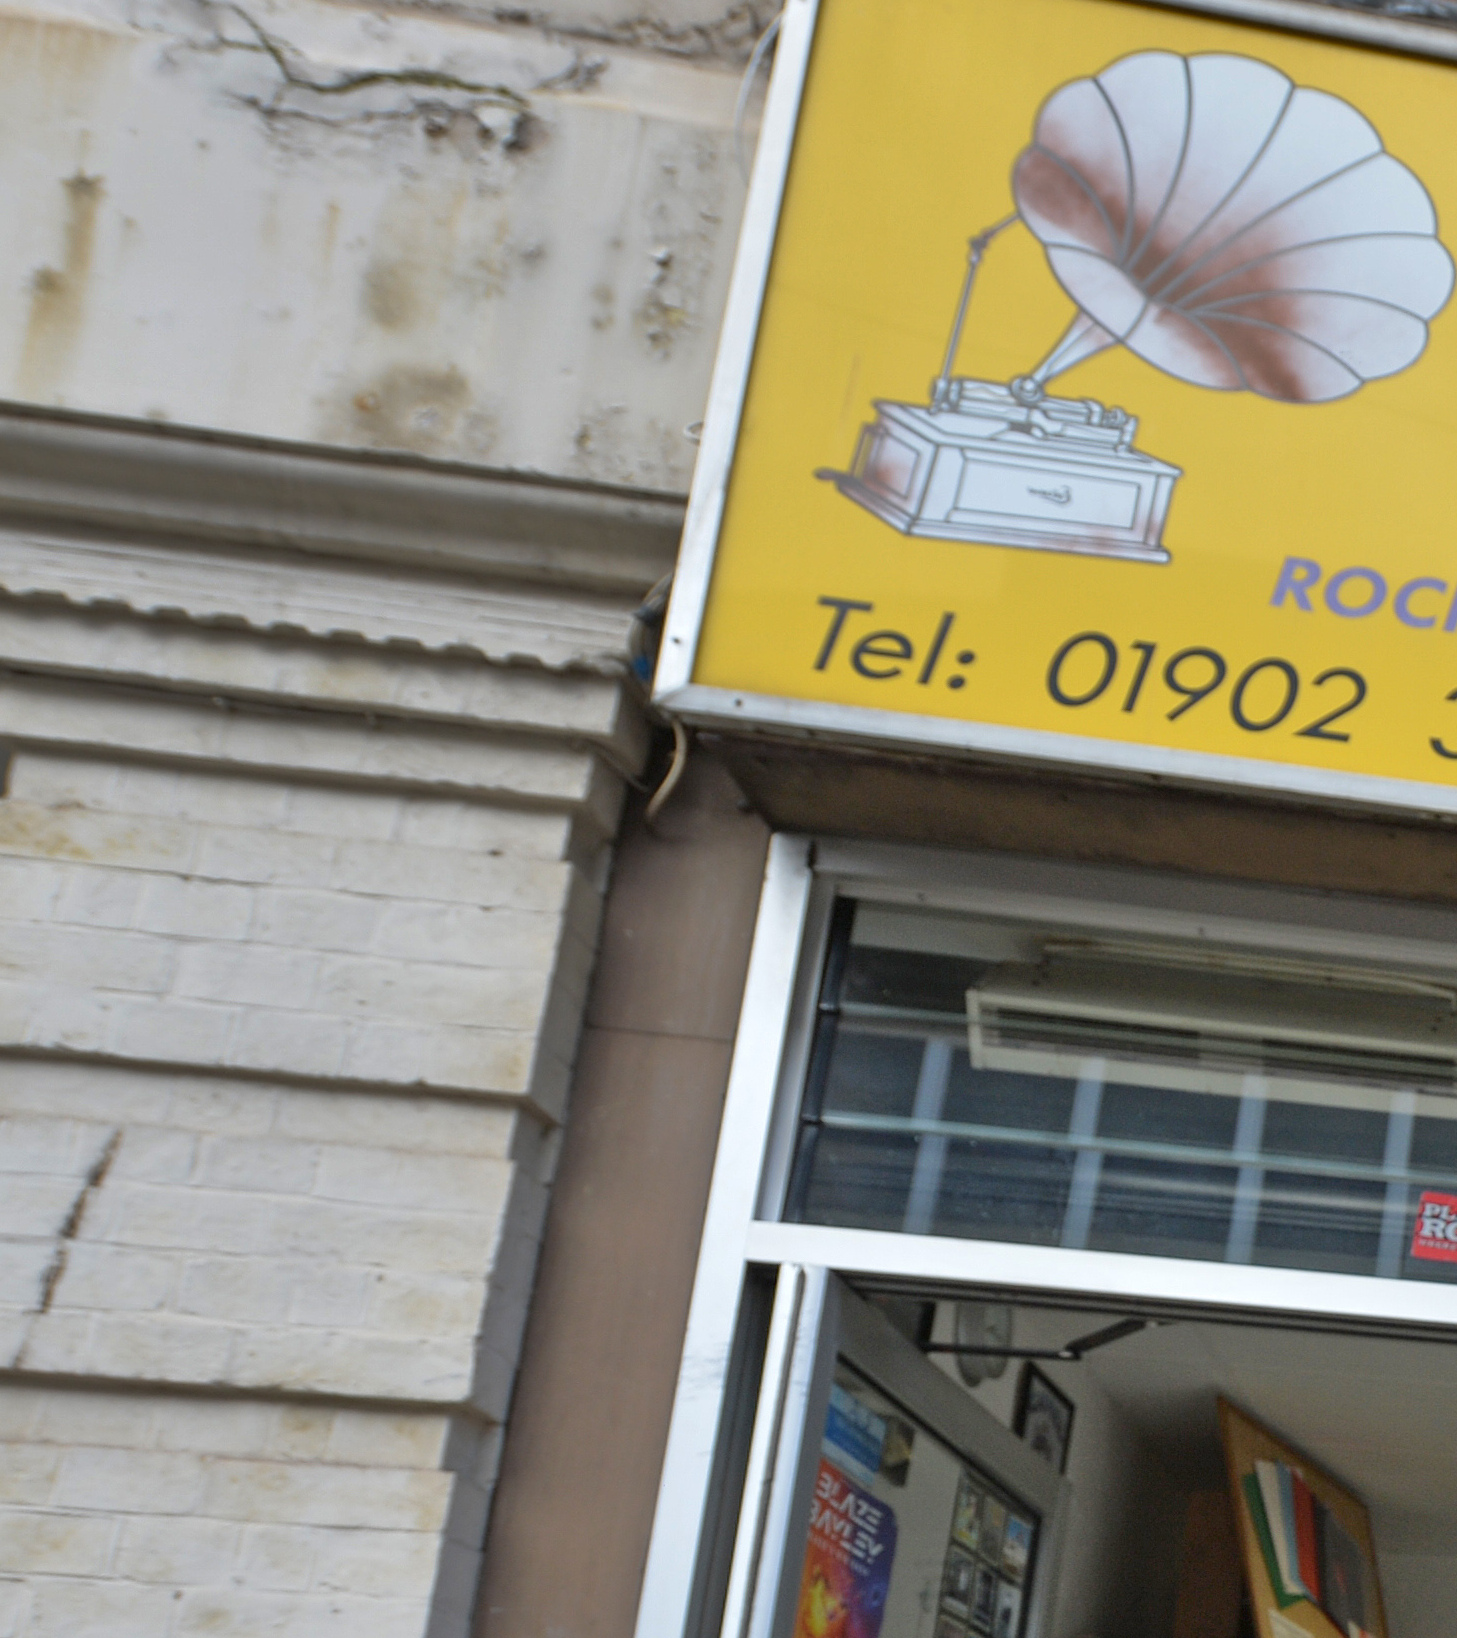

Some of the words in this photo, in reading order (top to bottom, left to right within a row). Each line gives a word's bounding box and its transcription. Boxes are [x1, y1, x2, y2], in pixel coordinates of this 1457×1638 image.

[812, 596, 977, 690] Tel:
[1046, 631, 1367, 744] 01902
[816, 1471, 885, 1534] BLAZE
